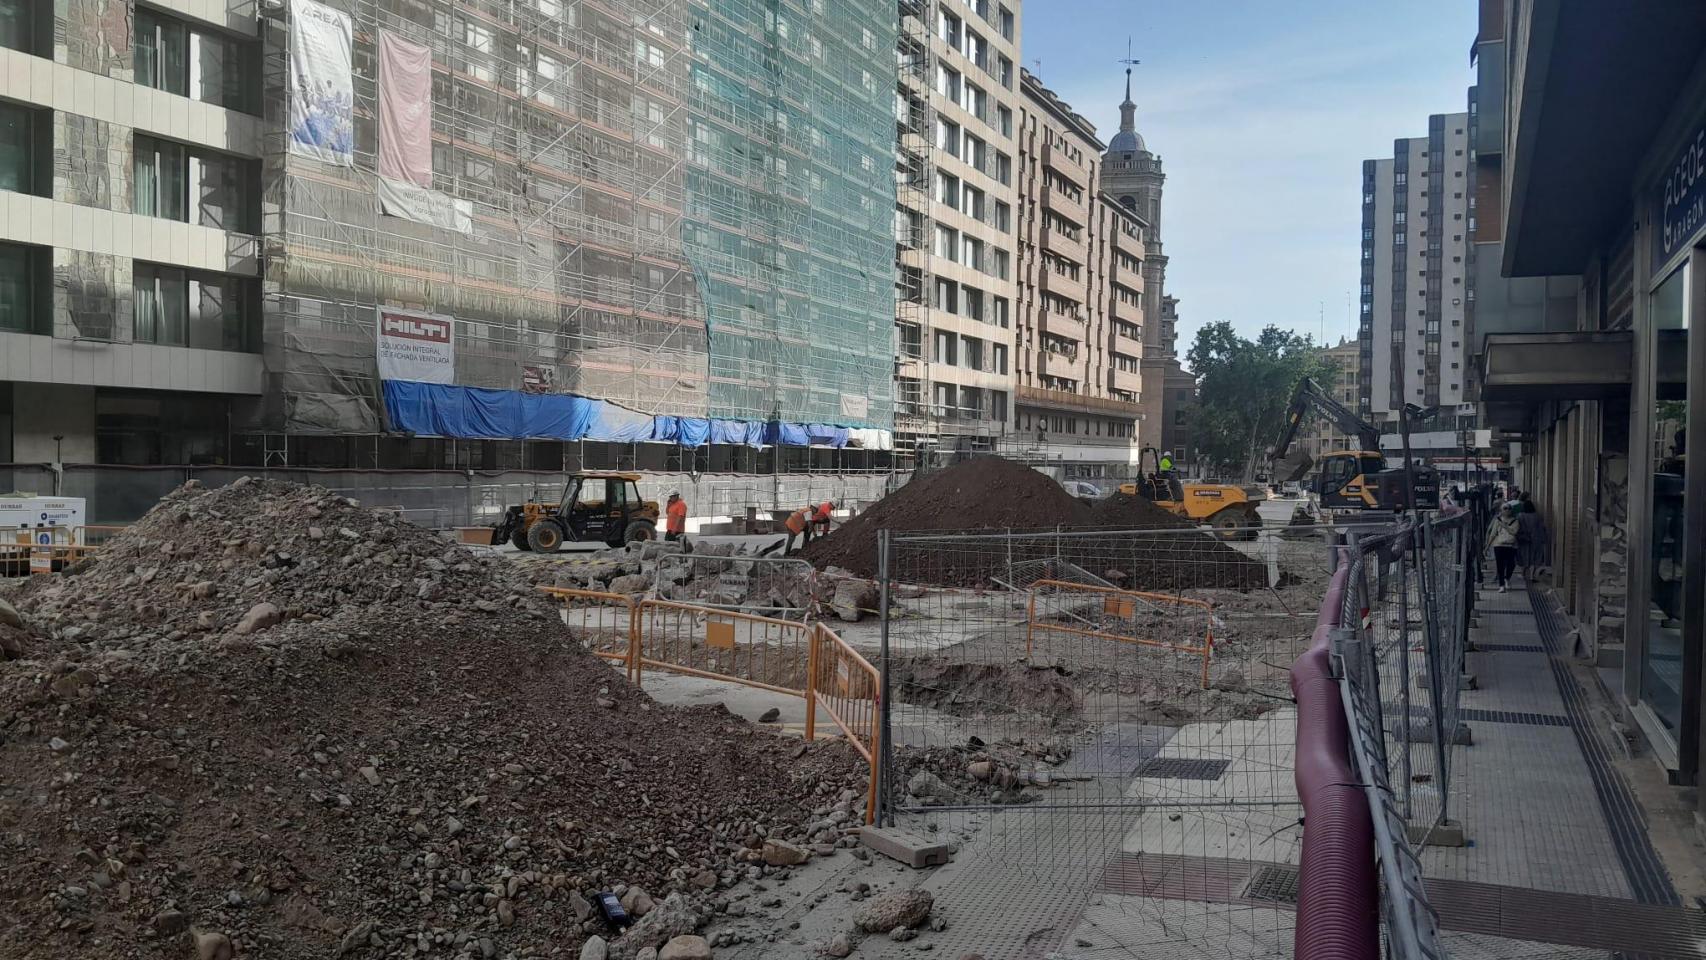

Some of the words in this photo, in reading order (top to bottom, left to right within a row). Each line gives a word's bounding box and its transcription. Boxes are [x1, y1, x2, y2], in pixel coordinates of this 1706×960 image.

[302, 7, 342, 28] AREA
[1673, 129, 1704, 206] CEOE
[1673, 194, 1704, 243] ARAGÓN
[385, 318, 447, 338] HILTI
[413, 345, 441, 355] INTEGRAL
[1316, 403, 1338, 422] VOLVO
